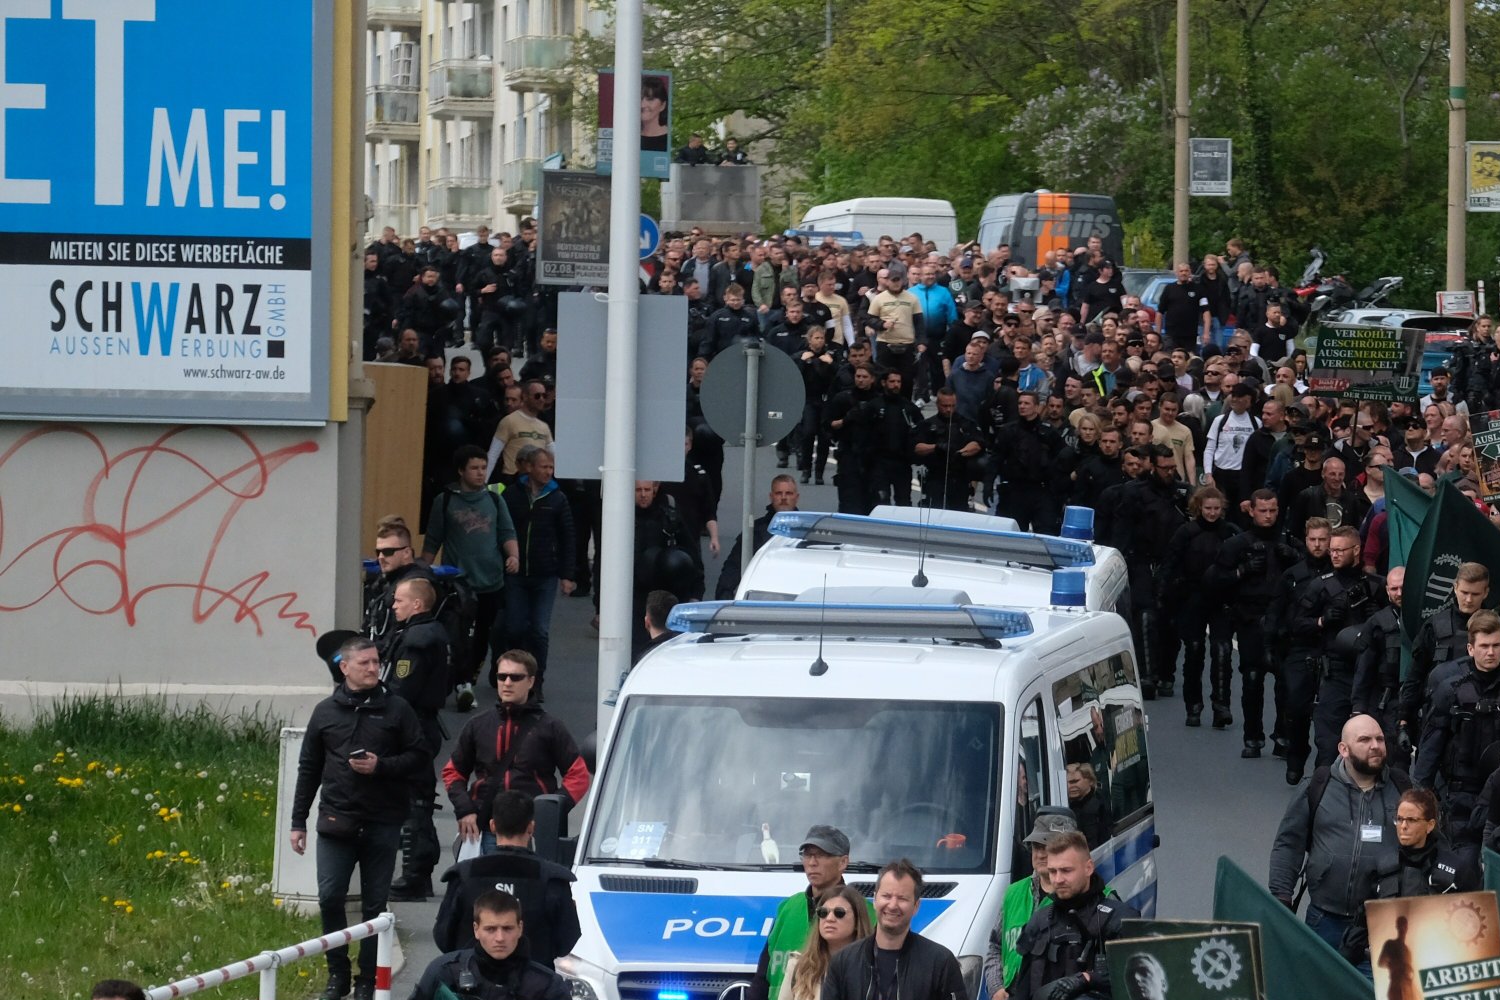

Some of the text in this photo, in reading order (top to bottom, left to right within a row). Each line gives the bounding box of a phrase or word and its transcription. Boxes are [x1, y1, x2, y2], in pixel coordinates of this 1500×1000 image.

[146, 107, 286, 210] ME!
[1022, 208, 1113, 238] trans
[50, 241, 284, 264] MIETEN SIE DIESE WERBEFLÄCHE
[544, 264, 574, 274] 02.08.
[50, 279, 262, 347] SCHWARZ
[1335, 329, 1394, 339] VERKOHLT
[1323, 339, 1403, 349] GESCHRÖDERT
[1318, 349, 1405, 359] AUSGEMERKELT
[1321, 359, 1400, 369] VERGAUCKELT
[183, 364, 286, 380] www.schwarz-aw.de
[1343, 391, 1416, 402] DER DRITTE WEG
[663, 917, 774, 940] POLI
